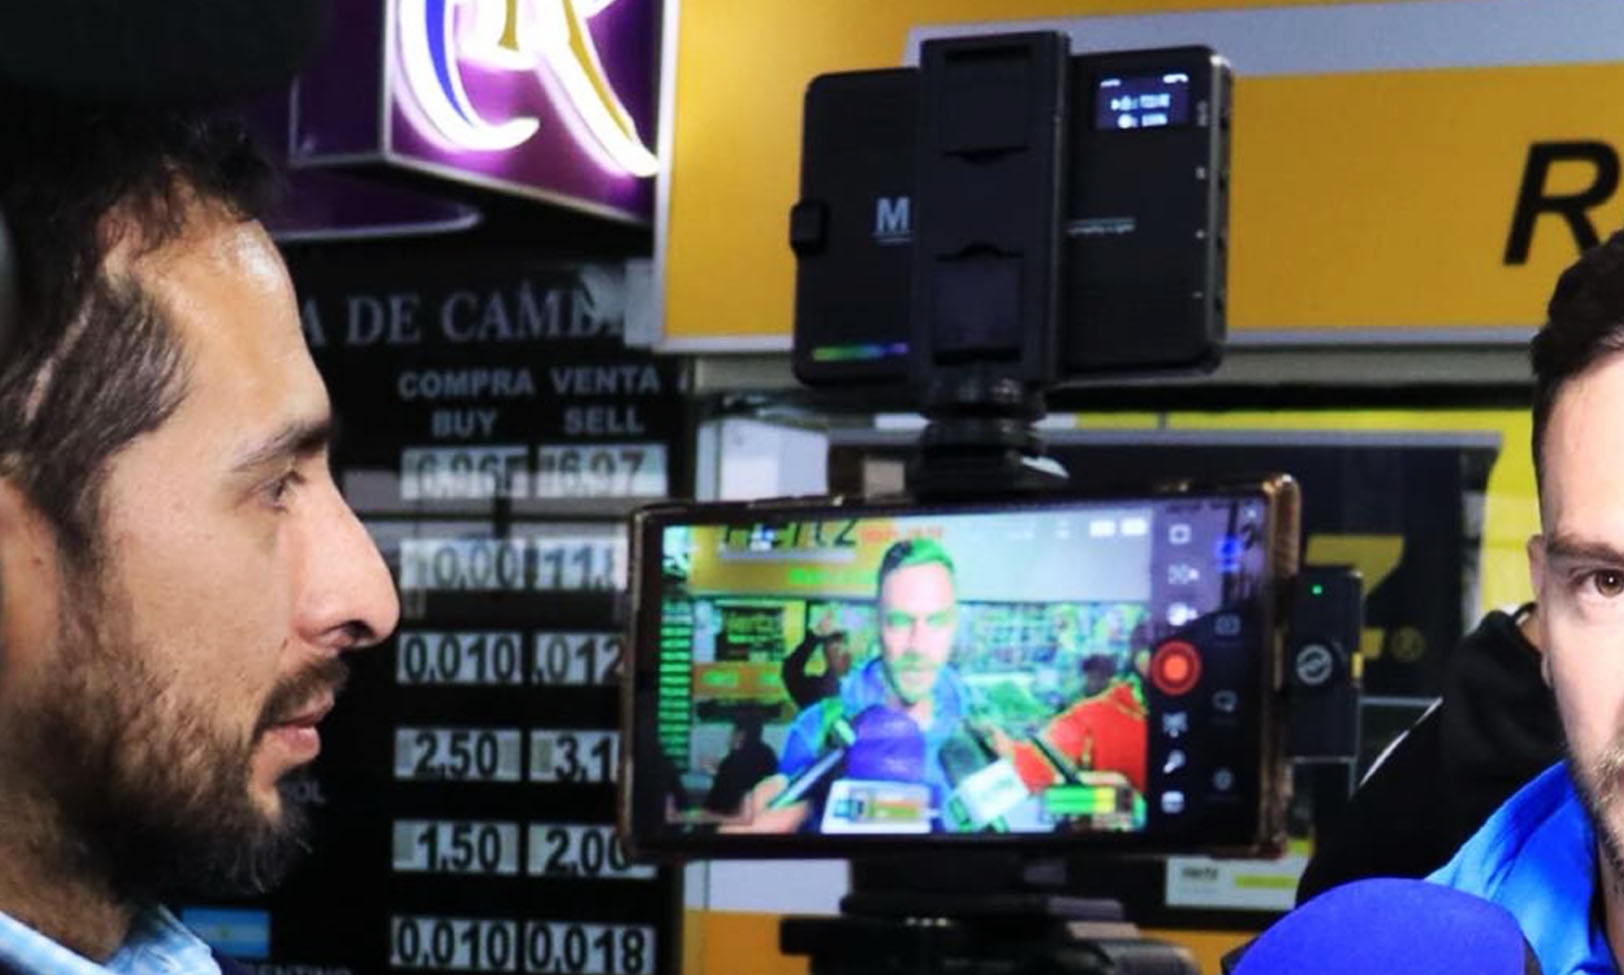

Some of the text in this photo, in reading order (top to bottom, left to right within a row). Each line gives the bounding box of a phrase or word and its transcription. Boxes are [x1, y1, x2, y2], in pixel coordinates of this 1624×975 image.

[876, 197, 911, 233] M
[347, 293, 421, 346] DE
[442, 284, 622, 341] CAMB
[399, 366, 661, 398] COMPRA VENTA
[431, 407, 646, 437] BUY SELL
[404, 636, 518, 684] 0,010
[414, 731, 613, 781] 2,50 3,1
[418, 824, 500, 871] 1,50
[400, 918, 645, 975] 0,010 0,018
